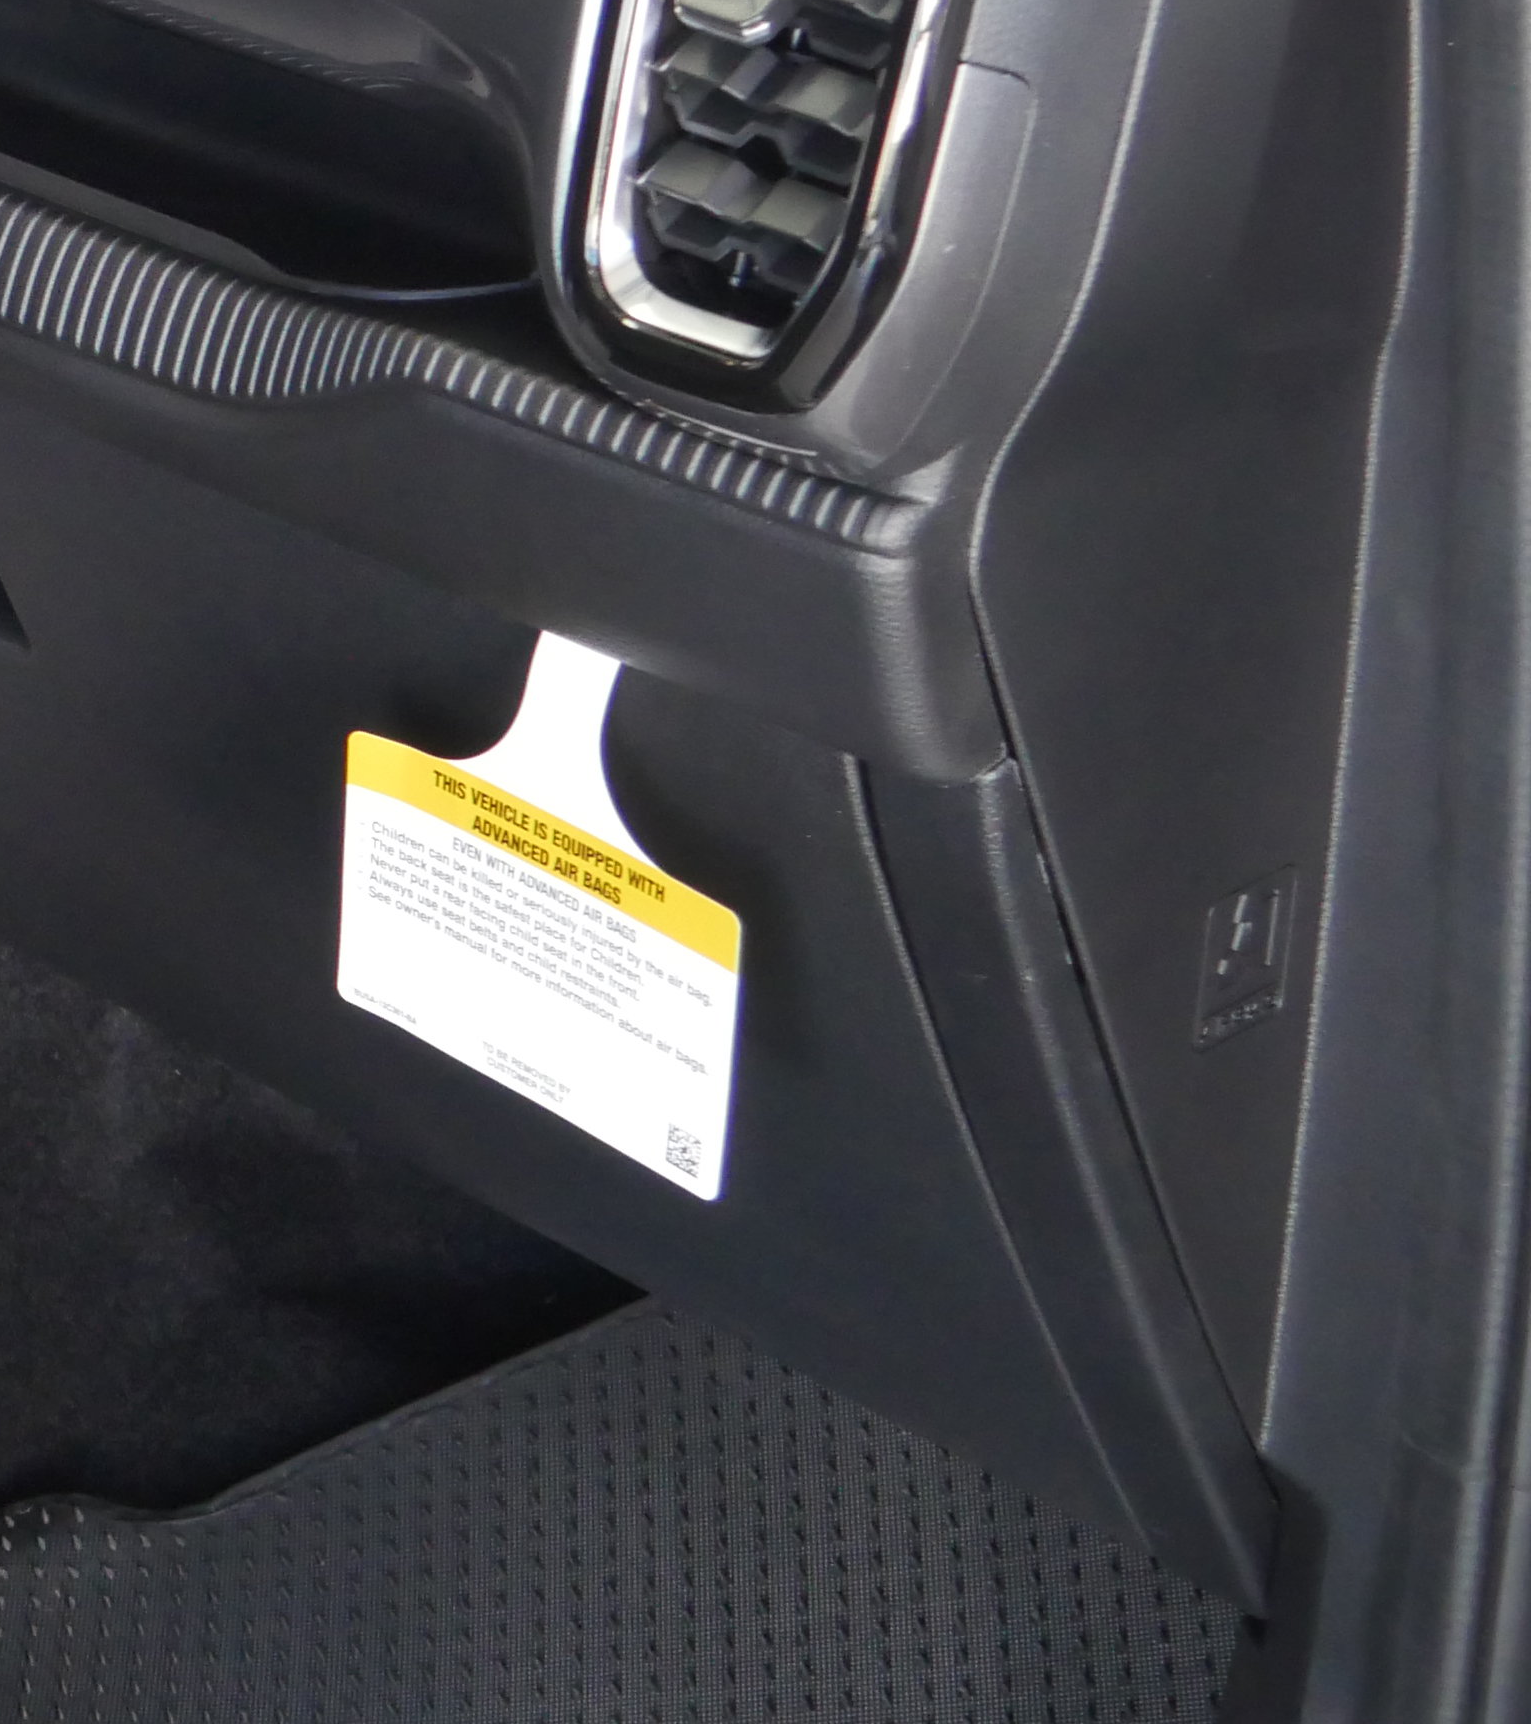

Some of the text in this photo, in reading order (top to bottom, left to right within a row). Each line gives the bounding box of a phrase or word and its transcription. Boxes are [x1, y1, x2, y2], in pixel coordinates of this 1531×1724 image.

[372, 836, 395, 856] The
[399, 848, 427, 871] back
[431, 866, 455, 886] seat
[458, 879, 468, 893] is
[472, 885, 490, 904] the
[495, 900, 530, 924] safest
[534, 920, 566, 943] place
[570, 936, 586, 953] for
[433, 770, 665, 903] THIS VEHICLE IS EQUIPPED WITH
[453, 837, 636, 943] EVEN WITH ADVANCED AIR BAGS
[472, 816, 621, 905] ADVANCED AIR BAGS
[369, 870, 413, 899] Always
[418, 894, 438, 911] use
[442, 907, 466, 926] seat
[469, 919, 498, 942] belts
[502, 938, 524, 956] and
[528, 952, 557, 973] child
[371, 853, 406, 878] Never
[411, 873, 430, 890] put
[433, 883, 440, 894] a
[443, 889, 464, 908] rear
[469, 901, 505, 932] facing
[510, 925, 539, 946] child
[543, 942, 567, 962] seat
[572, 957, 582, 969] in
[587, 963, 604, 981] the
[372, 821, 425, 852] Children
[429, 847, 449, 865] can
[453, 857, 468, 875] be
[471, 866, 503, 893] killed
[506, 887, 519, 901] or
[523, 896, 578, 933] seriously
[582, 927, 623, 956] injured
[627, 948, 641, 968] by
[645, 960, 665, 979] the
[668, 975, 683, 988] air
[369, 885, 391, 904] See
[395, 900, 440, 930] owner's
[444, 926, 487, 955] manual
[491, 947, 507, 964] for
[511, 961, 541, 983] more
[546, 978, 614, 1022] information
[618, 1019, 653, 1044] about
[656, 1039, 672, 1053] air
